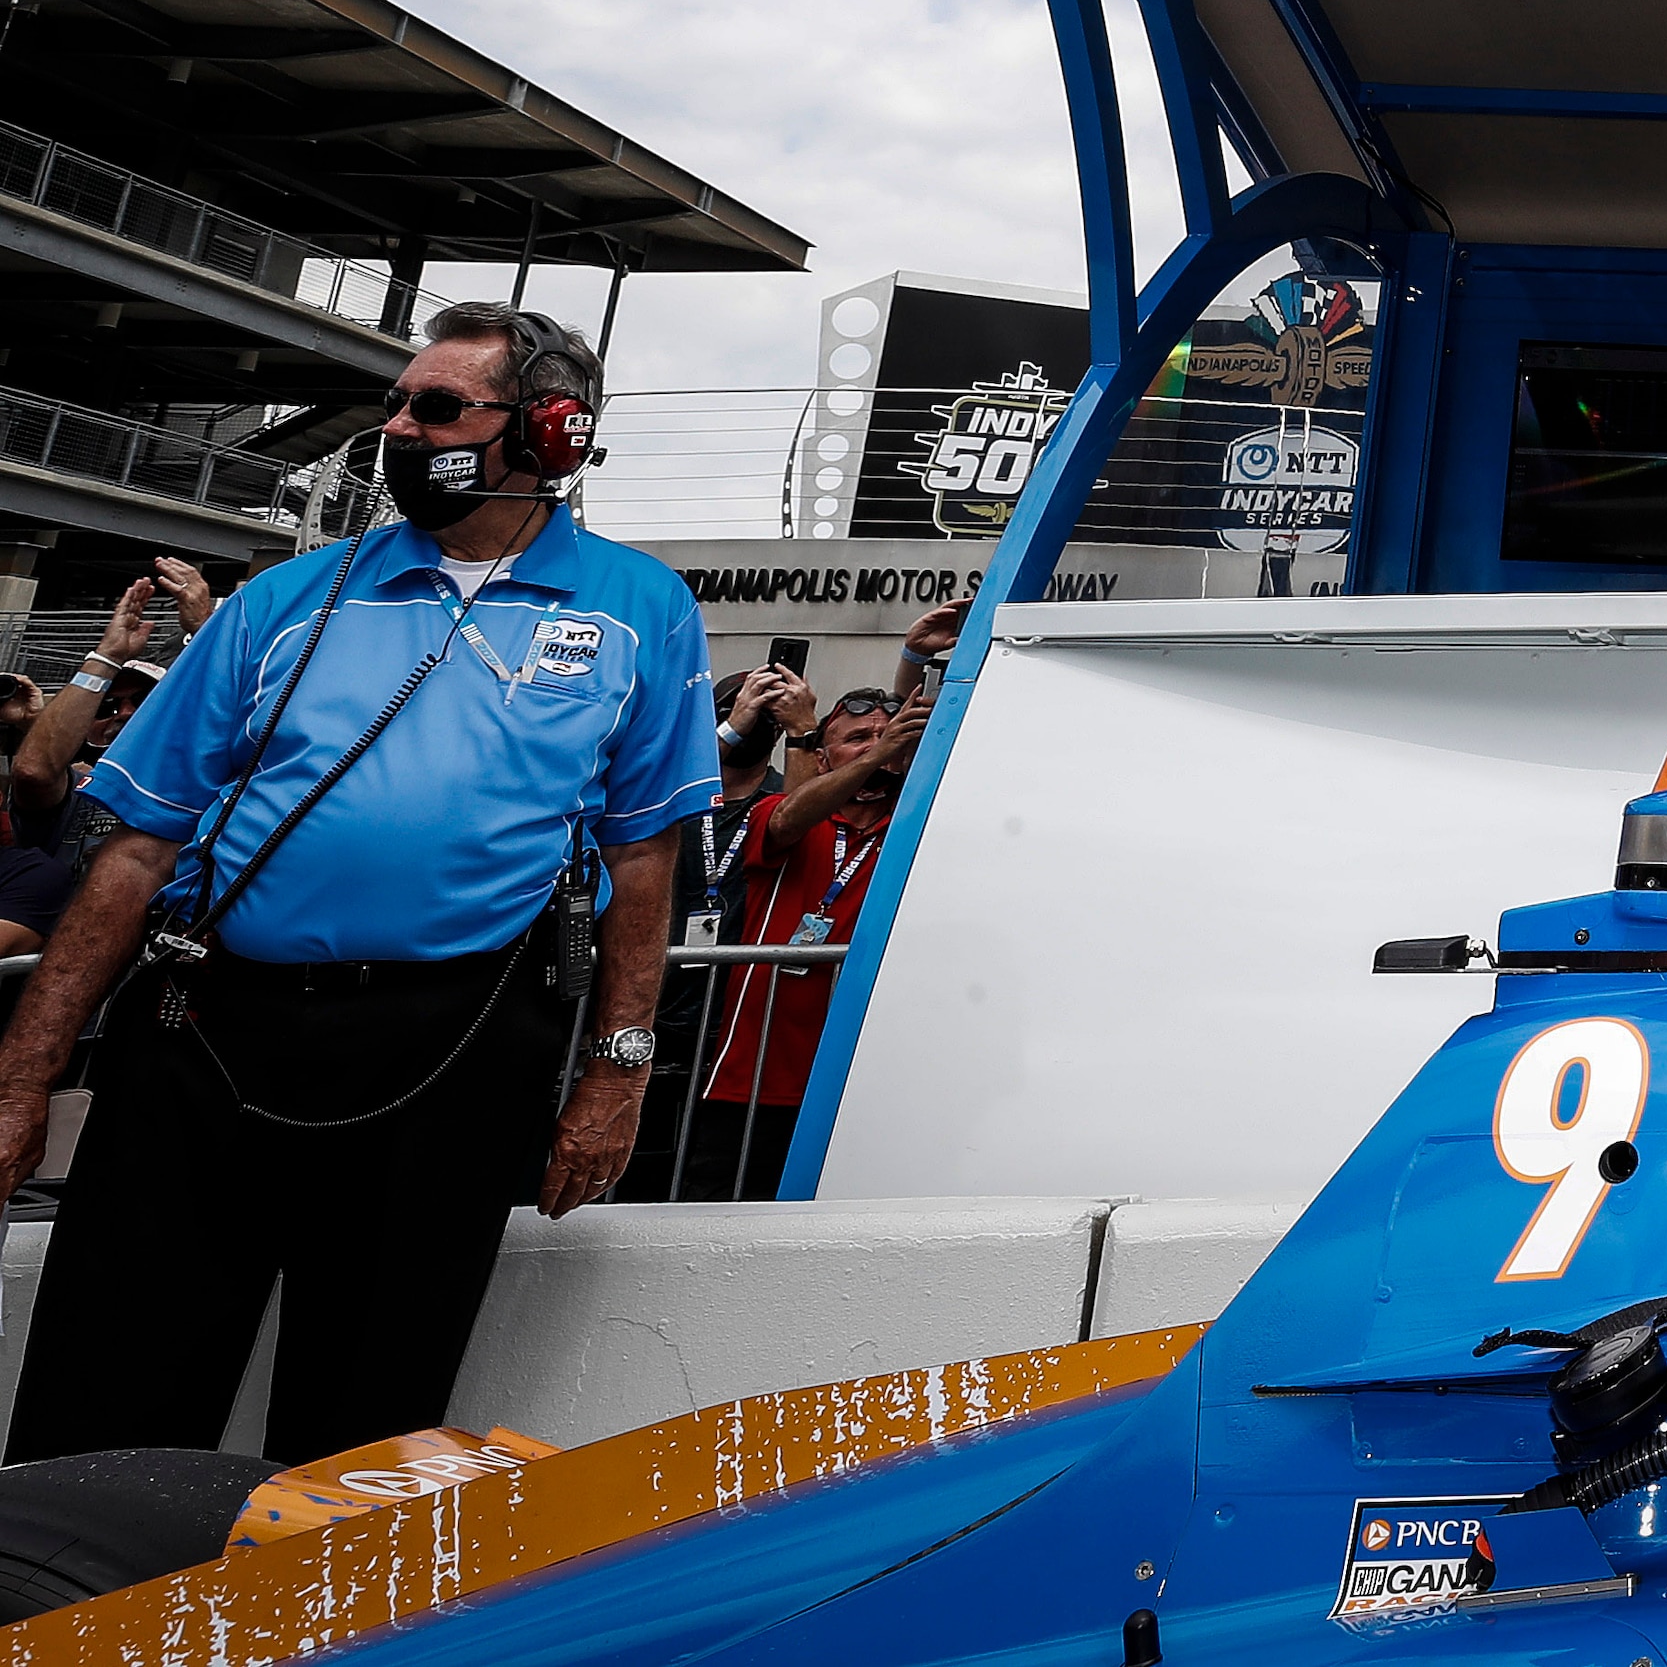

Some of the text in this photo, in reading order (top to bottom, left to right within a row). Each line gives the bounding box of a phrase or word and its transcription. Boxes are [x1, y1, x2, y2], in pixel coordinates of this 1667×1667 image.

[1183, 353, 1281, 375] NDIANAPOLIS
[966, 406, 1061, 440] INDY
[428, 466, 477, 482] INDYCAR
[926, 434, 1048, 495] 50
[1285, 451, 1347, 475] NTT
[1220, 488, 1354, 514] INDYCAR
[1245, 512, 1323, 526] SERIES
[674, 568, 852, 603] NDIANAPOLIS
[854, 568, 960, 603] MOTOR
[566, 630, 598, 642] NTT
[1493, 1016, 1650, 1284] 9
[1353, 1567, 1385, 1597] CHIP
